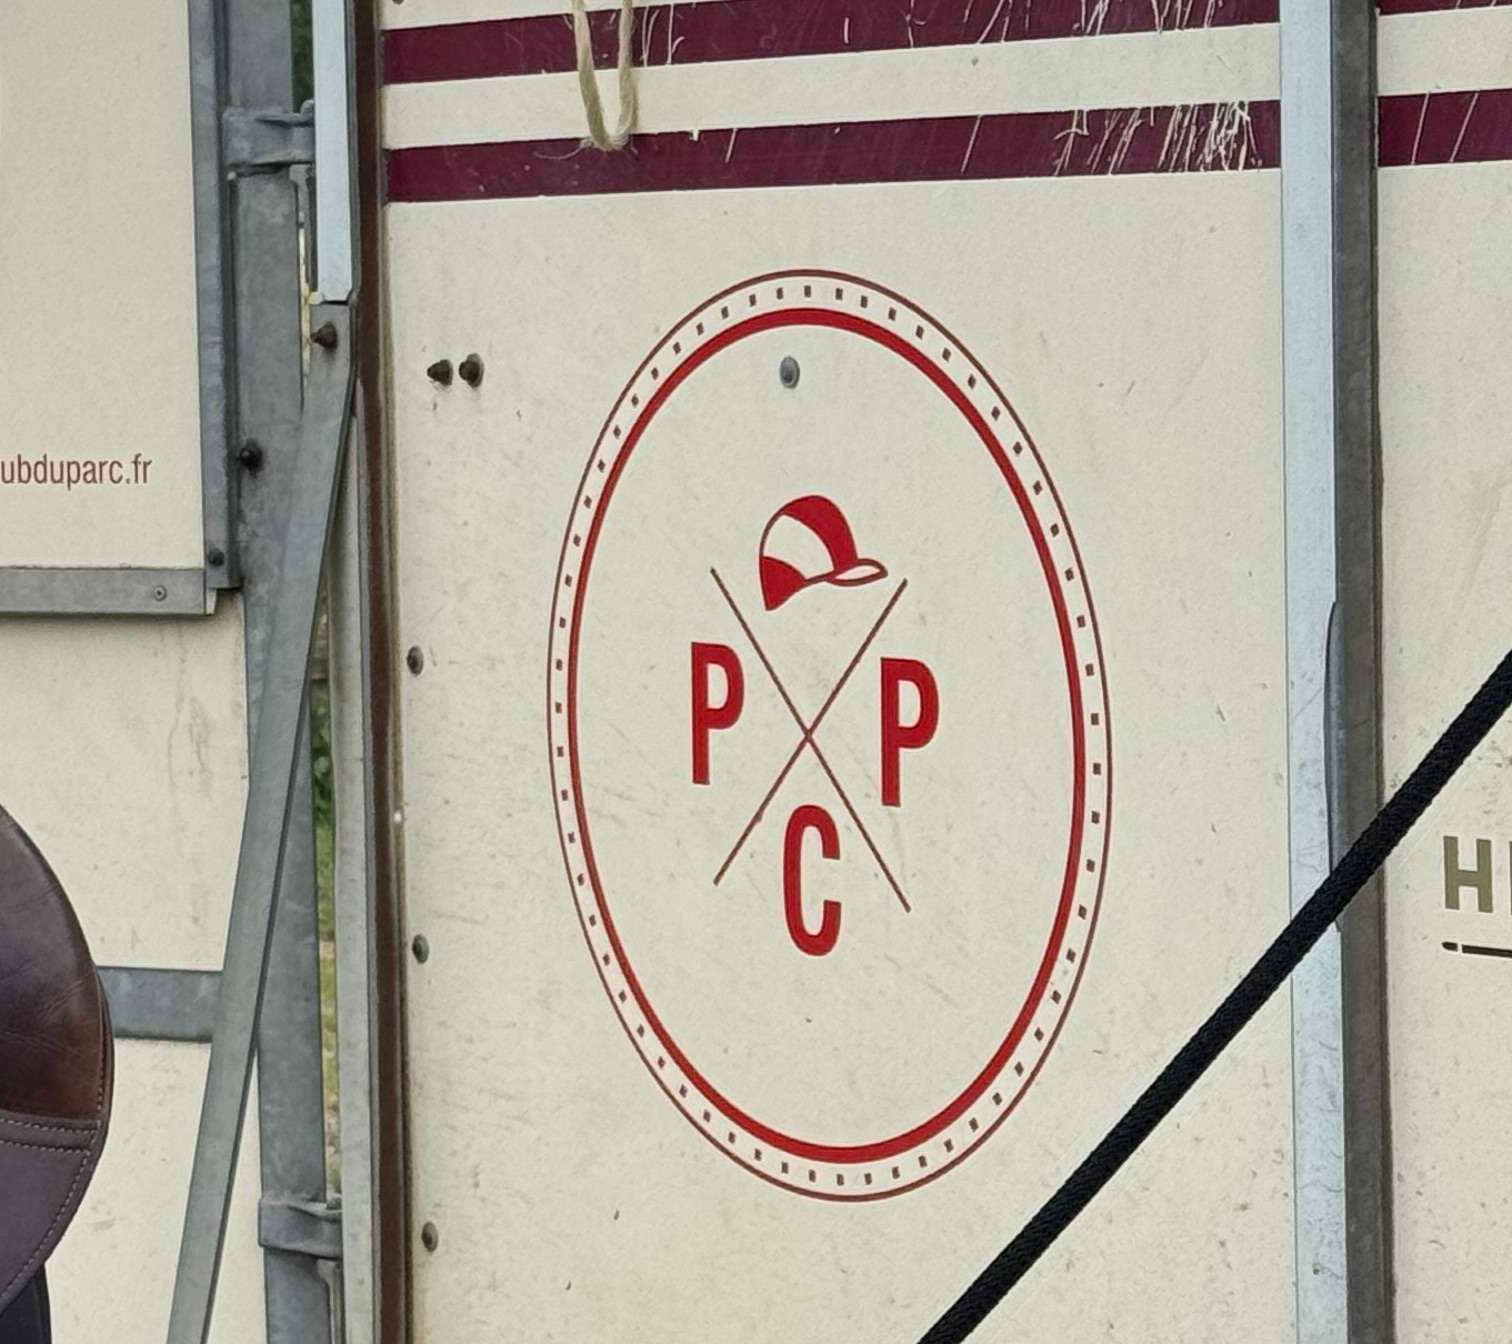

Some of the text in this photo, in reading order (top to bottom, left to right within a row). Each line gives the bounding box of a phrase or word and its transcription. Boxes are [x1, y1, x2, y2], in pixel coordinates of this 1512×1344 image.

[691, 642, 940, 807] P P
[783, 804, 842, 956] C
[1443, 835, 1512, 916] H
